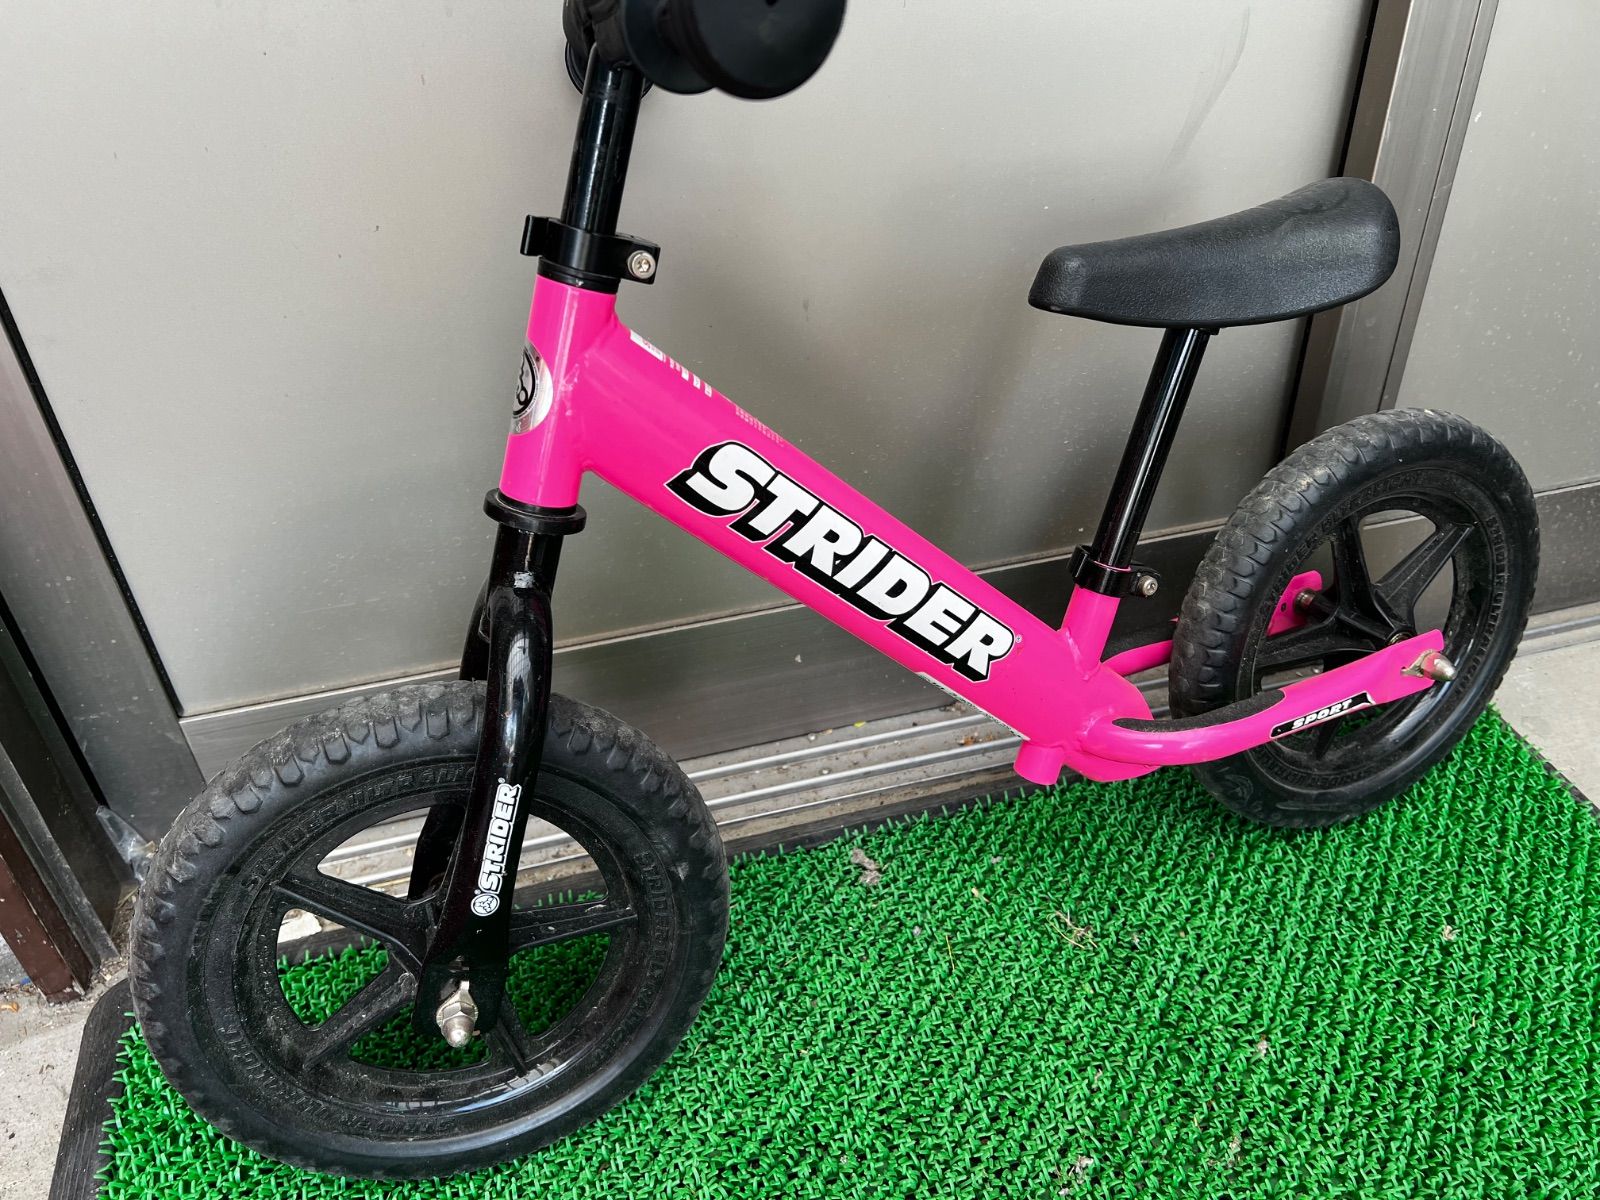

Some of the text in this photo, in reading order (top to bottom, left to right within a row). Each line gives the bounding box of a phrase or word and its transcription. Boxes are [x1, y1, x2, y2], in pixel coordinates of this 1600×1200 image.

[668, 441, 1014, 681] STRIDER
[1291, 698, 1353, 730] SPORT
[479, 783, 521, 894] STRIDER
